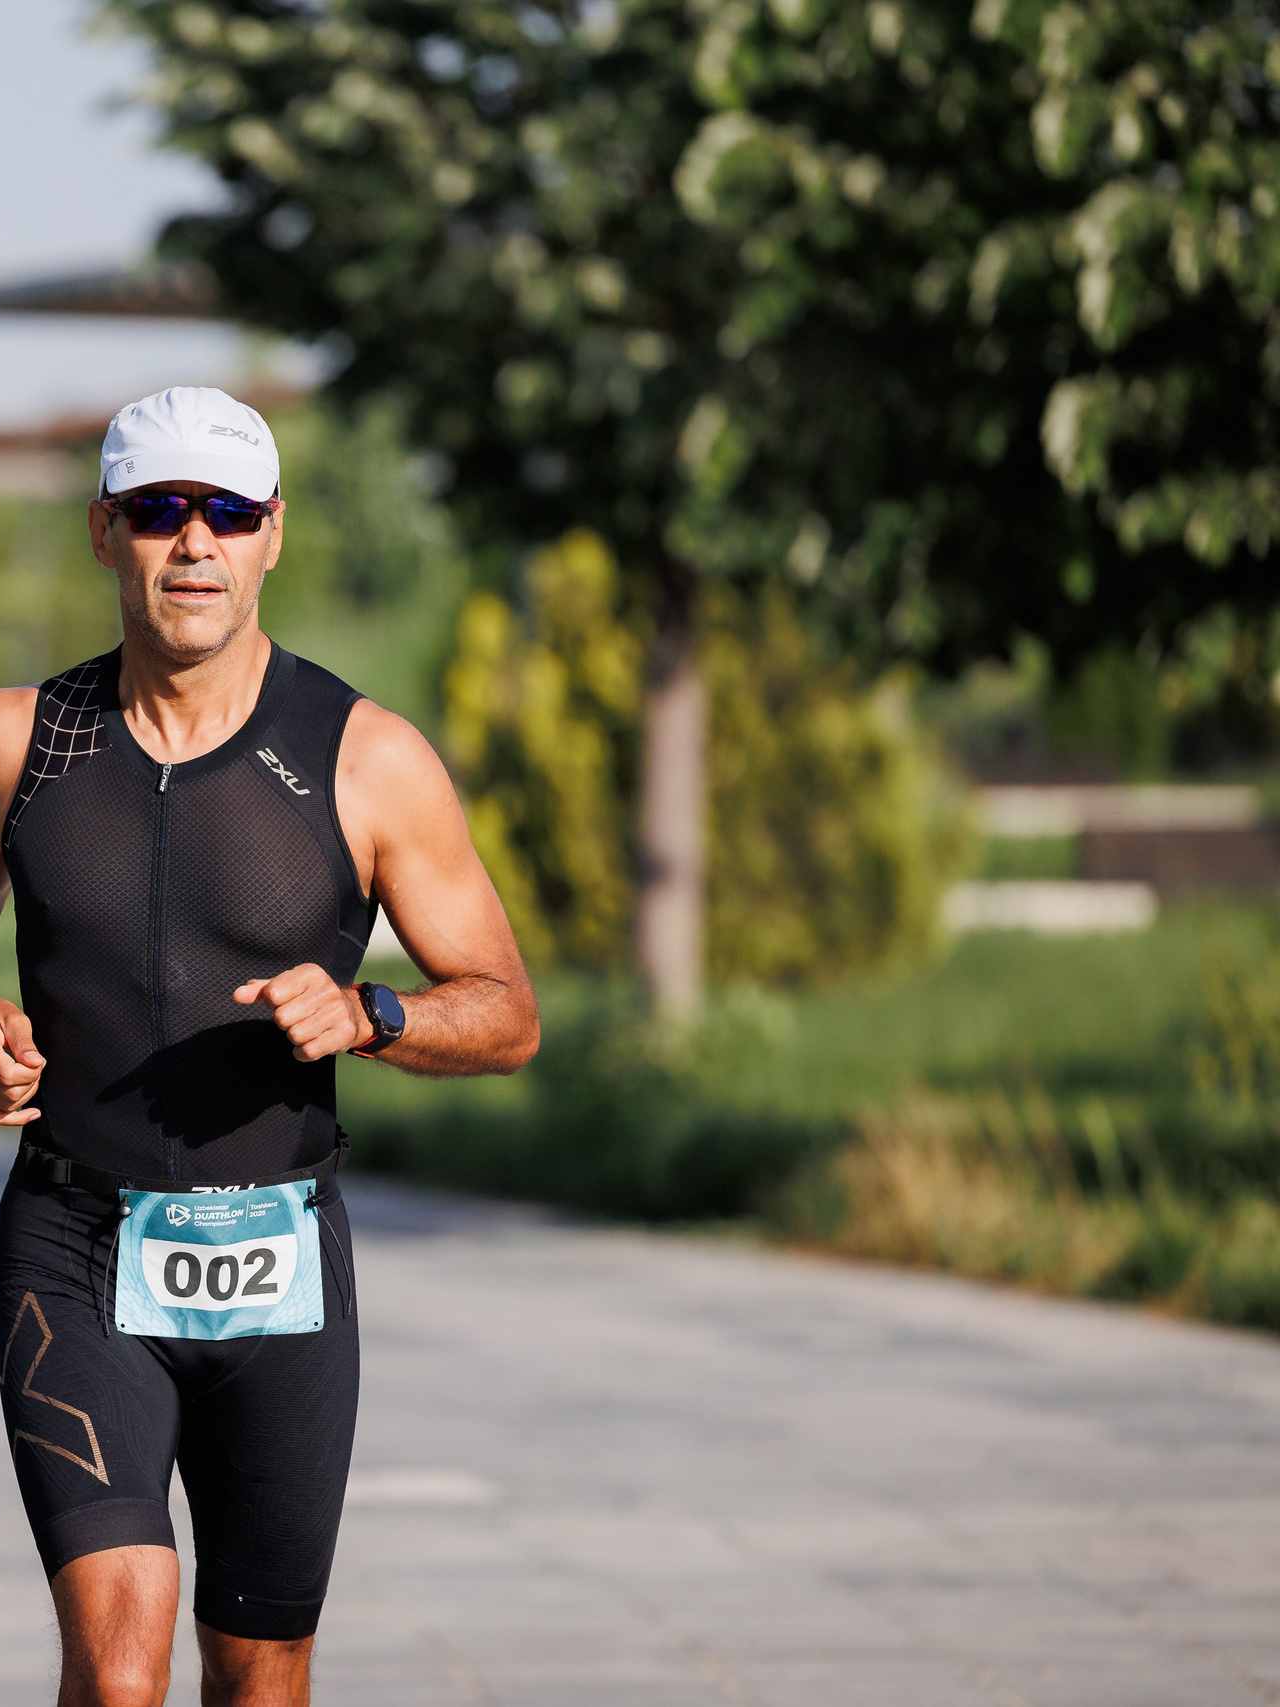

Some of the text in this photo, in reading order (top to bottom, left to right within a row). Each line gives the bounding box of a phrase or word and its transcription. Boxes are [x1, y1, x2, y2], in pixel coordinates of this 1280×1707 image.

[209, 424, 259, 446] 2XU
[256, 747, 311, 795] 2XU
[194, 1208, 245, 1220] DUATHLON
[249, 1210, 266, 1218] 2025
[194, 1219, 237, 1228] Championship
[163, 1247, 278, 1301] 002
